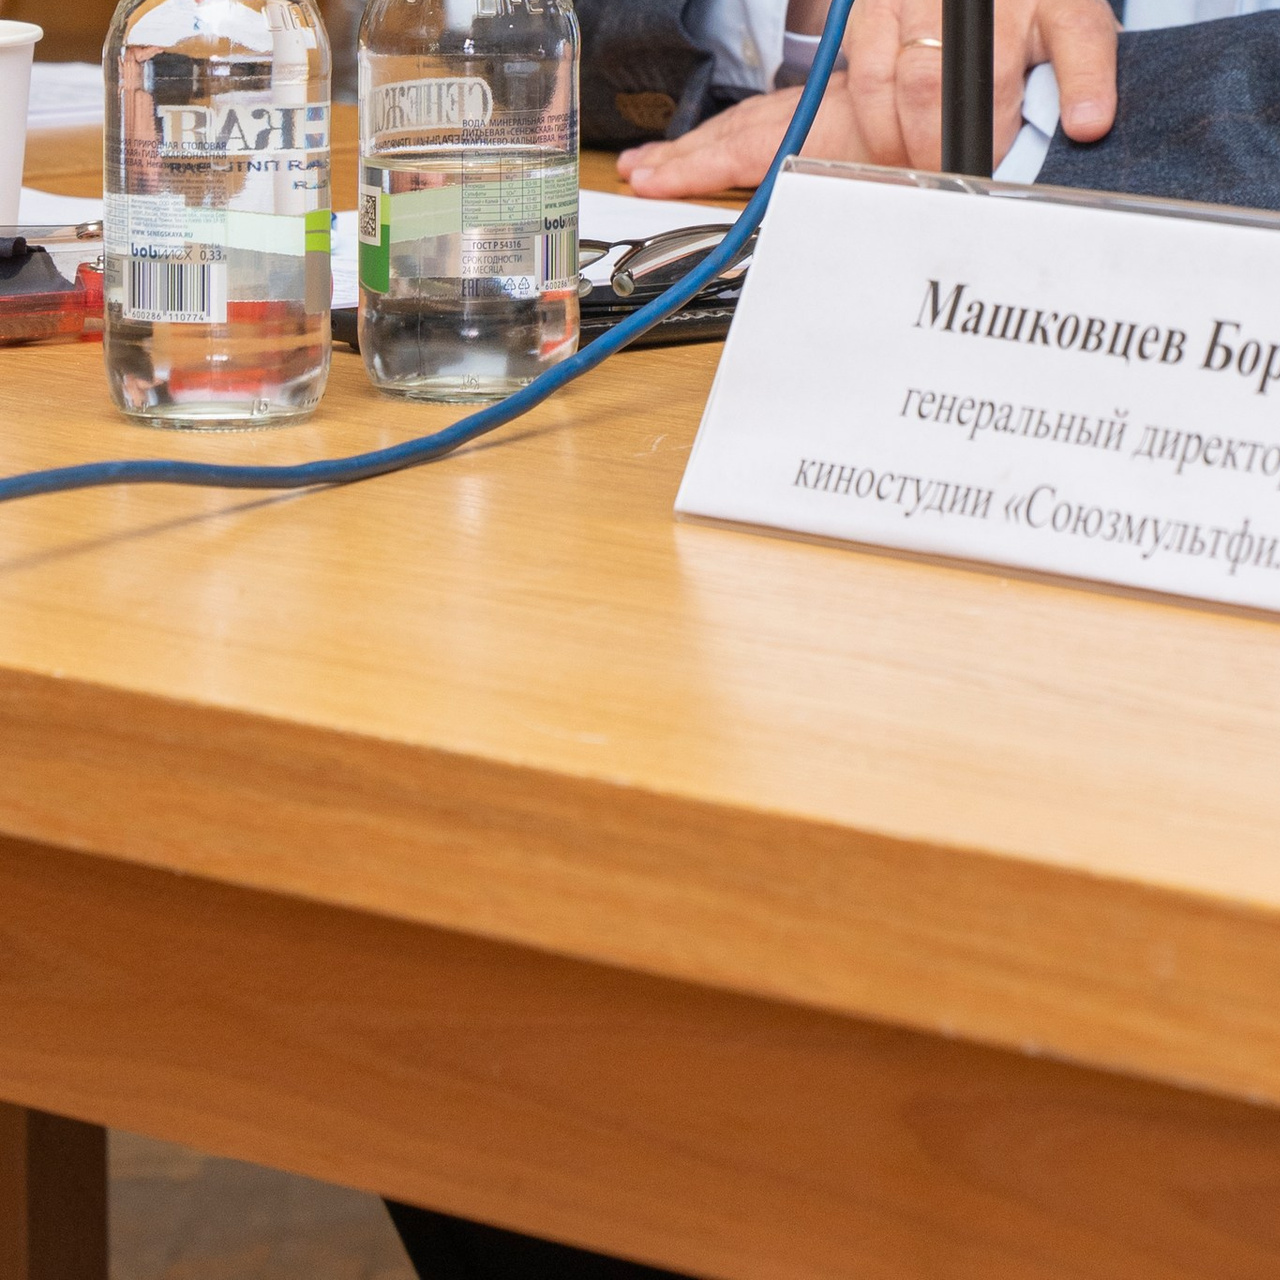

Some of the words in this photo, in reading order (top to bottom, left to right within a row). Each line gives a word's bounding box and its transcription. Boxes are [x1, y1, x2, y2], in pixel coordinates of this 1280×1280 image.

[462, 119, 486, 128] ВОДА
[472, 242, 492, 250] ГОСТ
[500, 240, 522, 249] 54316
[462, 256, 483, 265] СРОК
[483, 255, 523, 265] ГОДНОСТИ
[462, 266, 472, 275] 24
[472, 265, 505, 275] МЕСЯЦА
[131, 311, 162, 320] 600286
[169, 313, 205, 322] 110774
[912, 279, 1188, 366] Машковцев
[900, 386, 1129, 452] генеральный
[792, 458, 994, 519] киностудии
